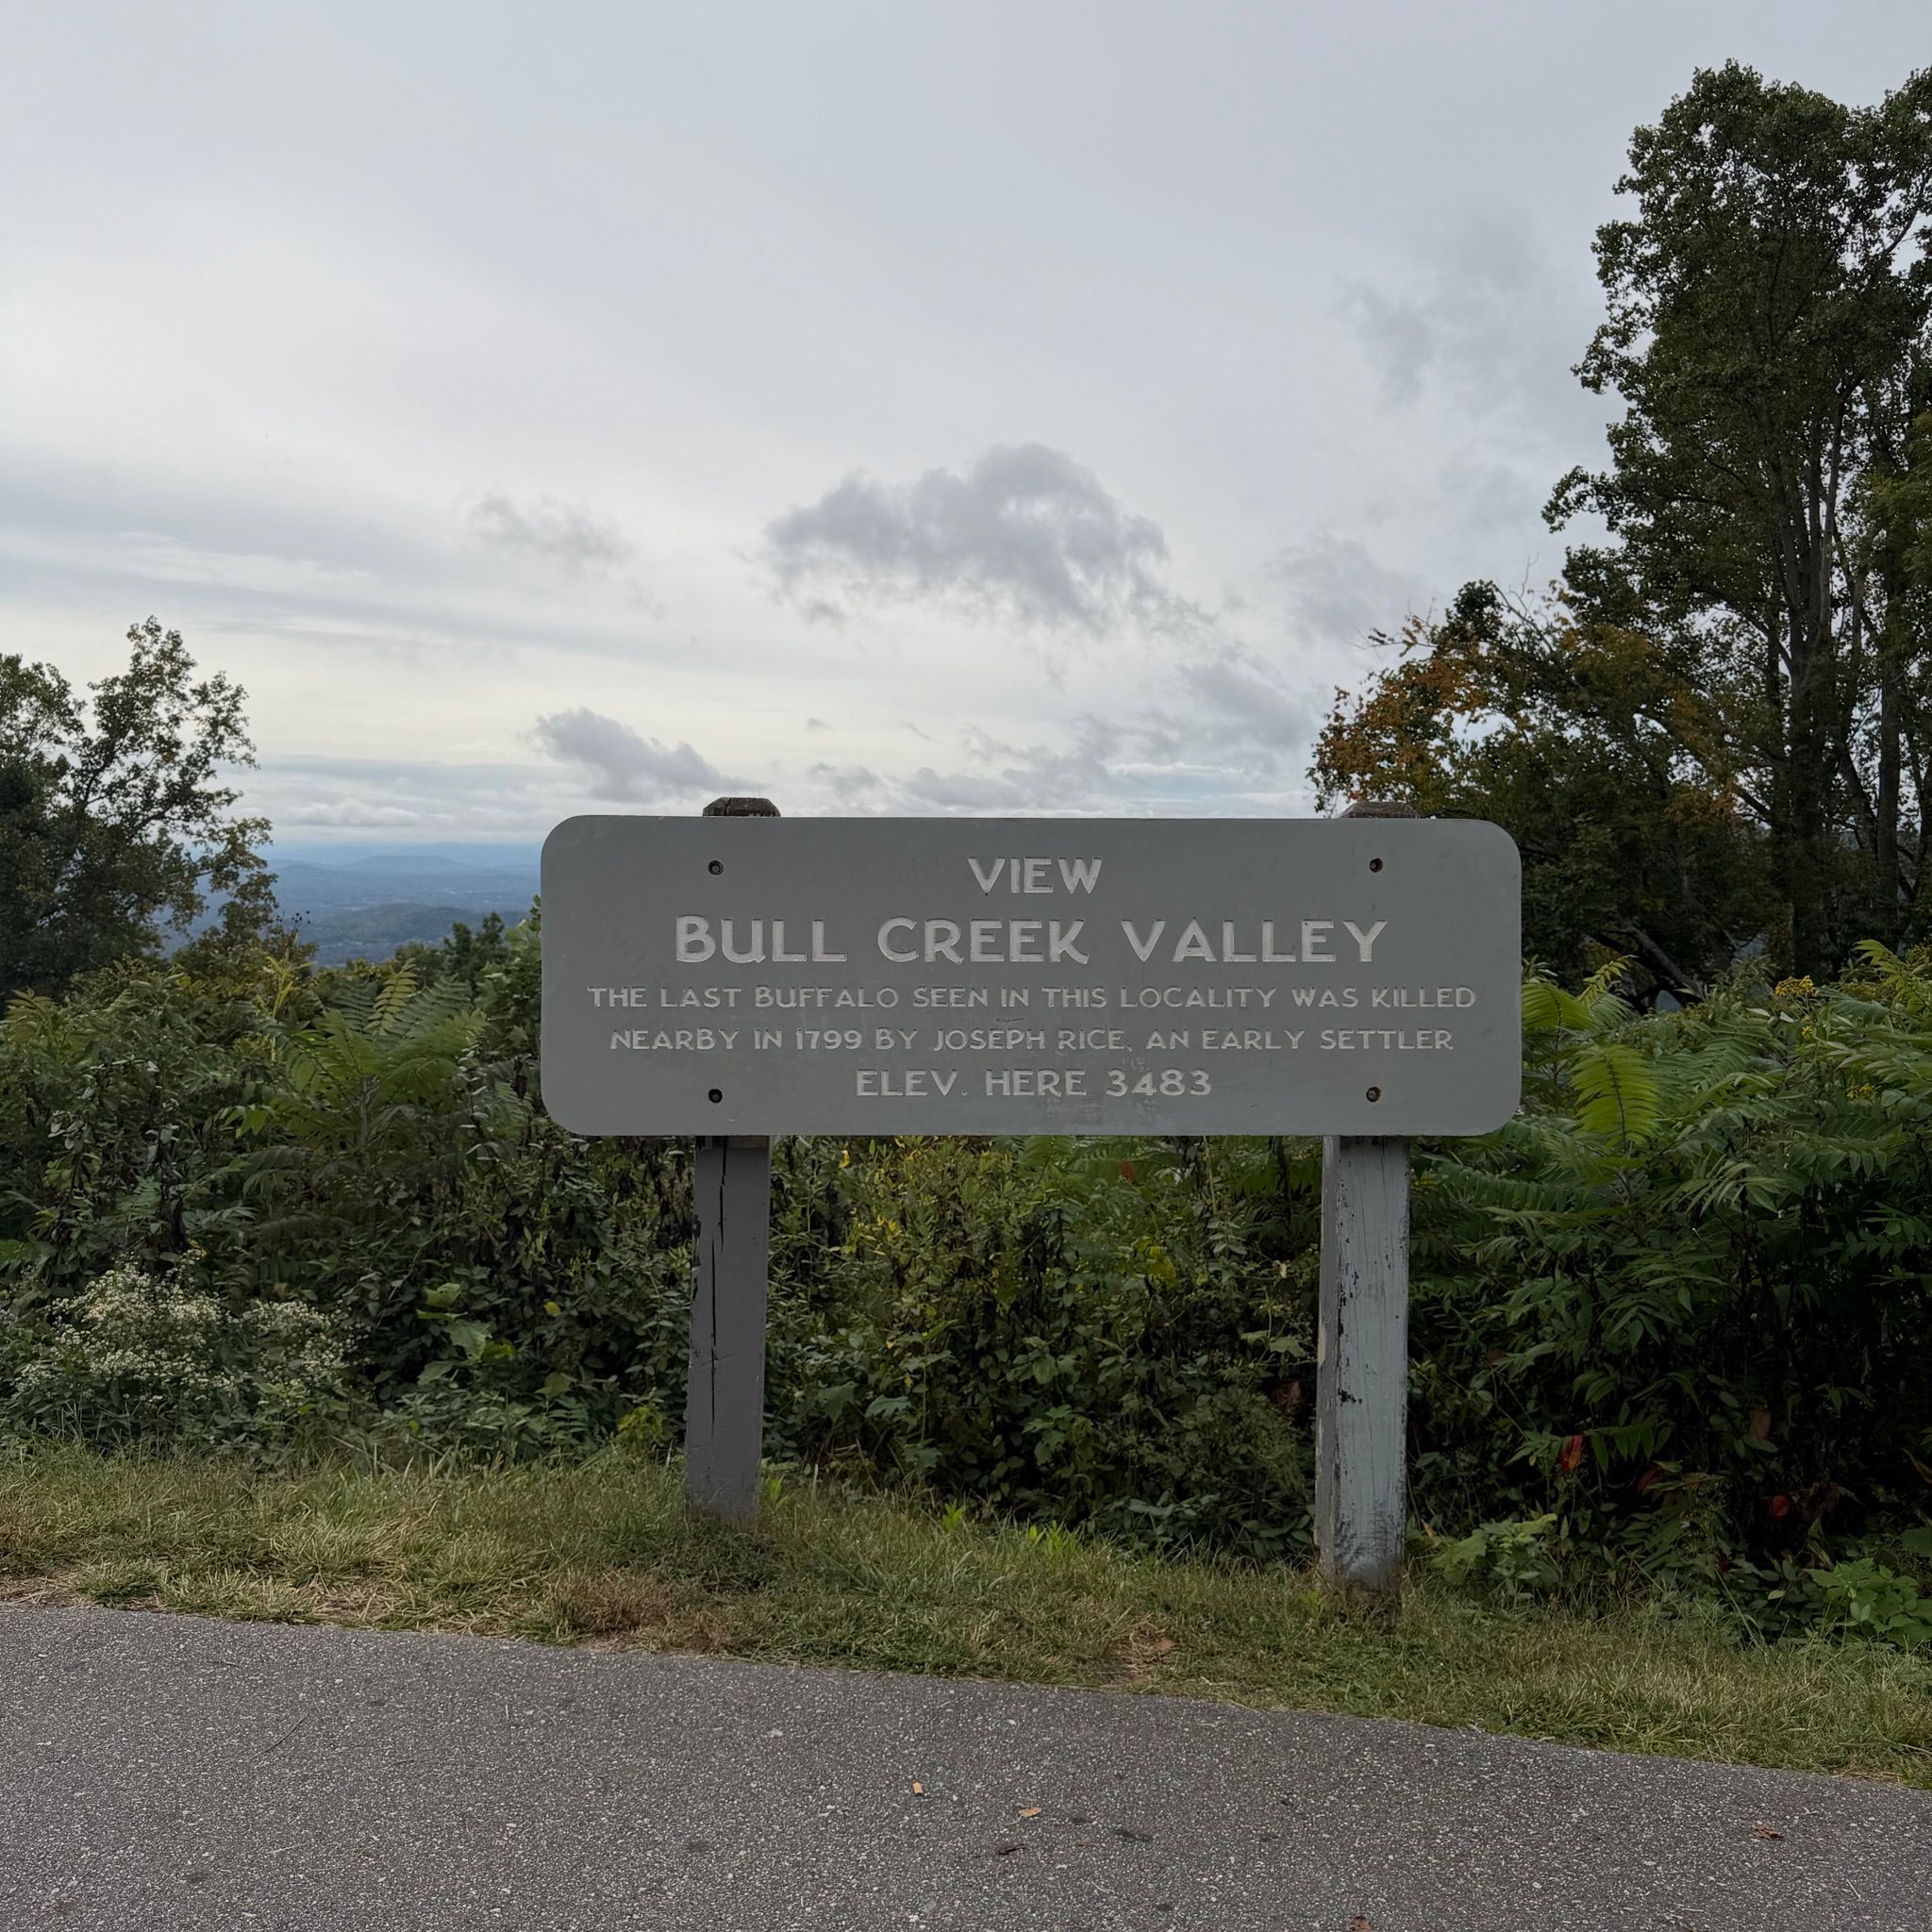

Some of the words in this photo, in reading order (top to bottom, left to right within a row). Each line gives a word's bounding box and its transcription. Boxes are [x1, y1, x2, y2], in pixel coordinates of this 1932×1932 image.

[967, 856, 1103, 894] VIEW
[675, 915, 848, 964] BULL
[877, 917, 1091, 965] CREEK
[1121, 919, 1389, 963] VALLEY
[587, 987, 647, 1008] THE
[660, 987, 742, 1008] LAST
[755, 986, 899, 1008] BUFFALO
[912, 986, 989, 1008] SEEN
[1000, 988, 1029, 1008] IN
[1041, 987, 1108, 1008] THIS
[1120, 987, 1276, 1008] LOCALITY
[1291, 987, 1359, 1008] WAS
[1372, 987, 1476, 1008] KILLED
[609, 1027, 741, 1051] NEARBY
[754, 1027, 783, 1050] IN
[795, 1027, 863, 1050] 1799
[875, 1028, 918, 1050] BY
[933, 1028, 1046, 1052] JOSEPH
[1145, 1029, 1190, 1050] AN
[1202, 1029, 1306, 1050] EARLY
[1320, 1029, 1454, 1050] SETTLER
[856, 1069, 968, 1097] ELEV.
[985, 1069, 1088, 1098] HERE
[1106, 1068, 1213, 1098] 3483
